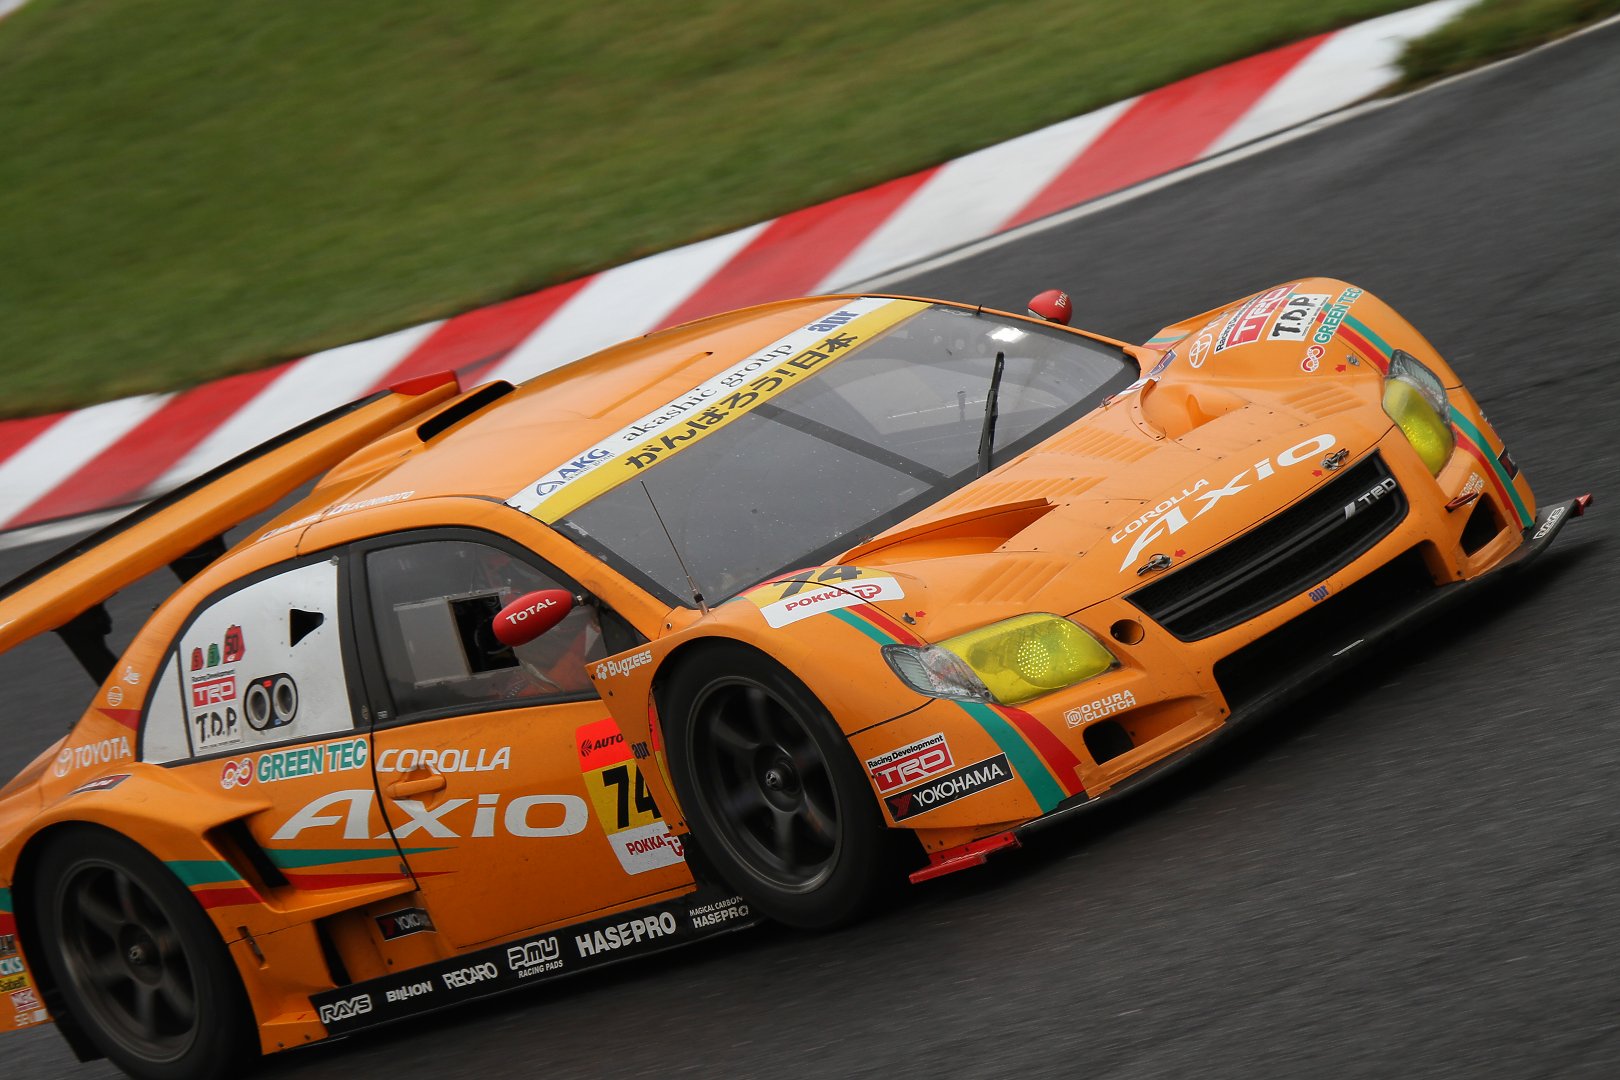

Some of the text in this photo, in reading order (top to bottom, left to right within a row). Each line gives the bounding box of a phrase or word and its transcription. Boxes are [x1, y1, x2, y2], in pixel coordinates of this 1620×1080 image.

[808, 310, 860, 333] apr
[1233, 287, 1288, 342] TRD
[1313, 304, 1351, 345] GREEN
[622, 343, 793, 442] akashic group
[624, 332, 860, 470] がんばろう!日本
[558, 448, 610, 479] AKG
[1357, 476, 1397, 506] TRD
[1110, 477, 1210, 546] COROLLA
[773, 566, 863, 600] 74
[1308, 583, 1328, 603] apr
[505, 597, 557, 626] TOTAL
[786, 587, 849, 612] POKKA
[193, 681, 235, 704] TRD
[1081, 690, 1134, 715] OGURA
[1083, 696, 1137, 723] CLUTCH
[75, 736, 132, 769] TOYOTA
[257, 743, 324, 784] GREEN
[328, 738, 368, 772] TEC
[375, 746, 511, 773] COROLLA
[631, 741, 650, 760] apr
[867, 734, 944, 770] Racing Development
[877, 748, 947, 789] TRD
[602, 764, 662, 830] 74
[912, 763, 1005, 808] YOKOHAMA
[625, 835, 668, 856] POKKA
[690, 895, 743, 917] MAGICAL CARBON
[692, 905, 749, 929] HASEPRO
[575, 911, 677, 958] HASEPRO
[442, 962, 498, 989] RECARO
[518, 959, 564, 979] RACING PADS
[386, 980, 433, 1003] BILLION
[320, 993, 373, 1024] RAYS
